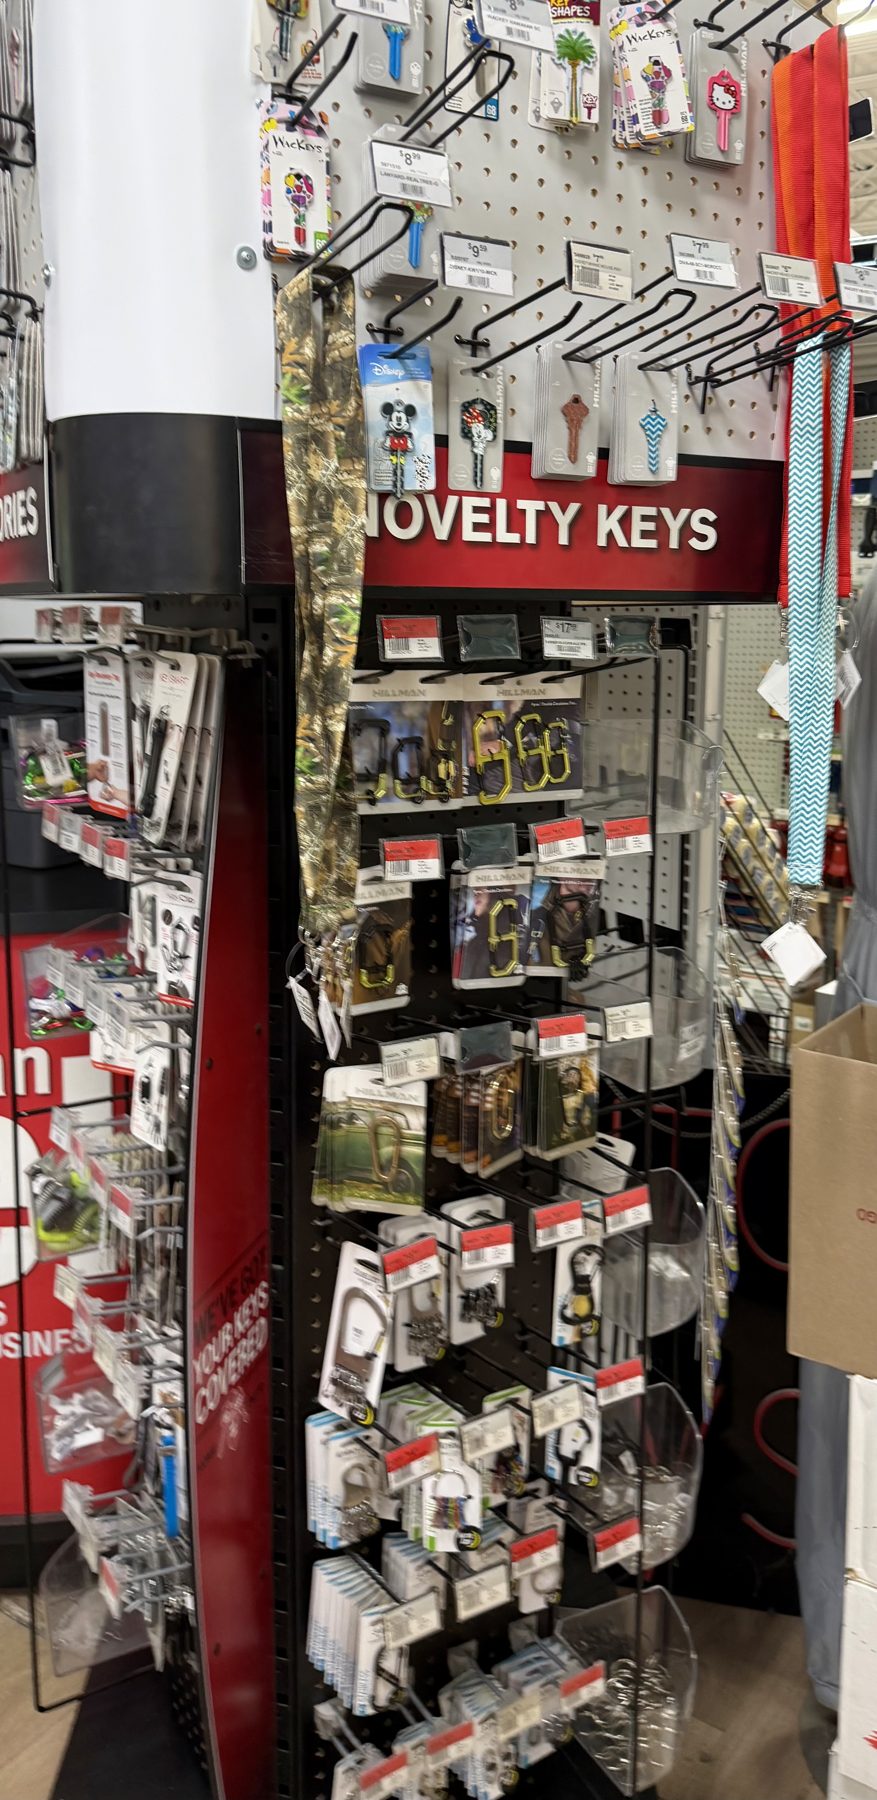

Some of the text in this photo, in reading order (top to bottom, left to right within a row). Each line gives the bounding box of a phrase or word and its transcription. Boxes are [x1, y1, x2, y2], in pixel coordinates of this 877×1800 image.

[551, 6, 590, 17] SHAPES
[740, 40, 749, 97] HILLMAN
[369, 362, 406, 379] Disney
[496, 364, 505, 424] HILLMAN
[597, 503, 719, 551] KEYS
[372, 689, 426, 697] HILLMAN
[496, 688, 547, 697] HILLMAN
[474, 873, 526, 883] HILLMAN
[543, 865, 600, 876] HILLMAN
[357, 886, 405, 901] LLMAN
[192, 1280, 269, 1384] YOUR KEYS
[194, 1316, 269, 1425] COVERED
